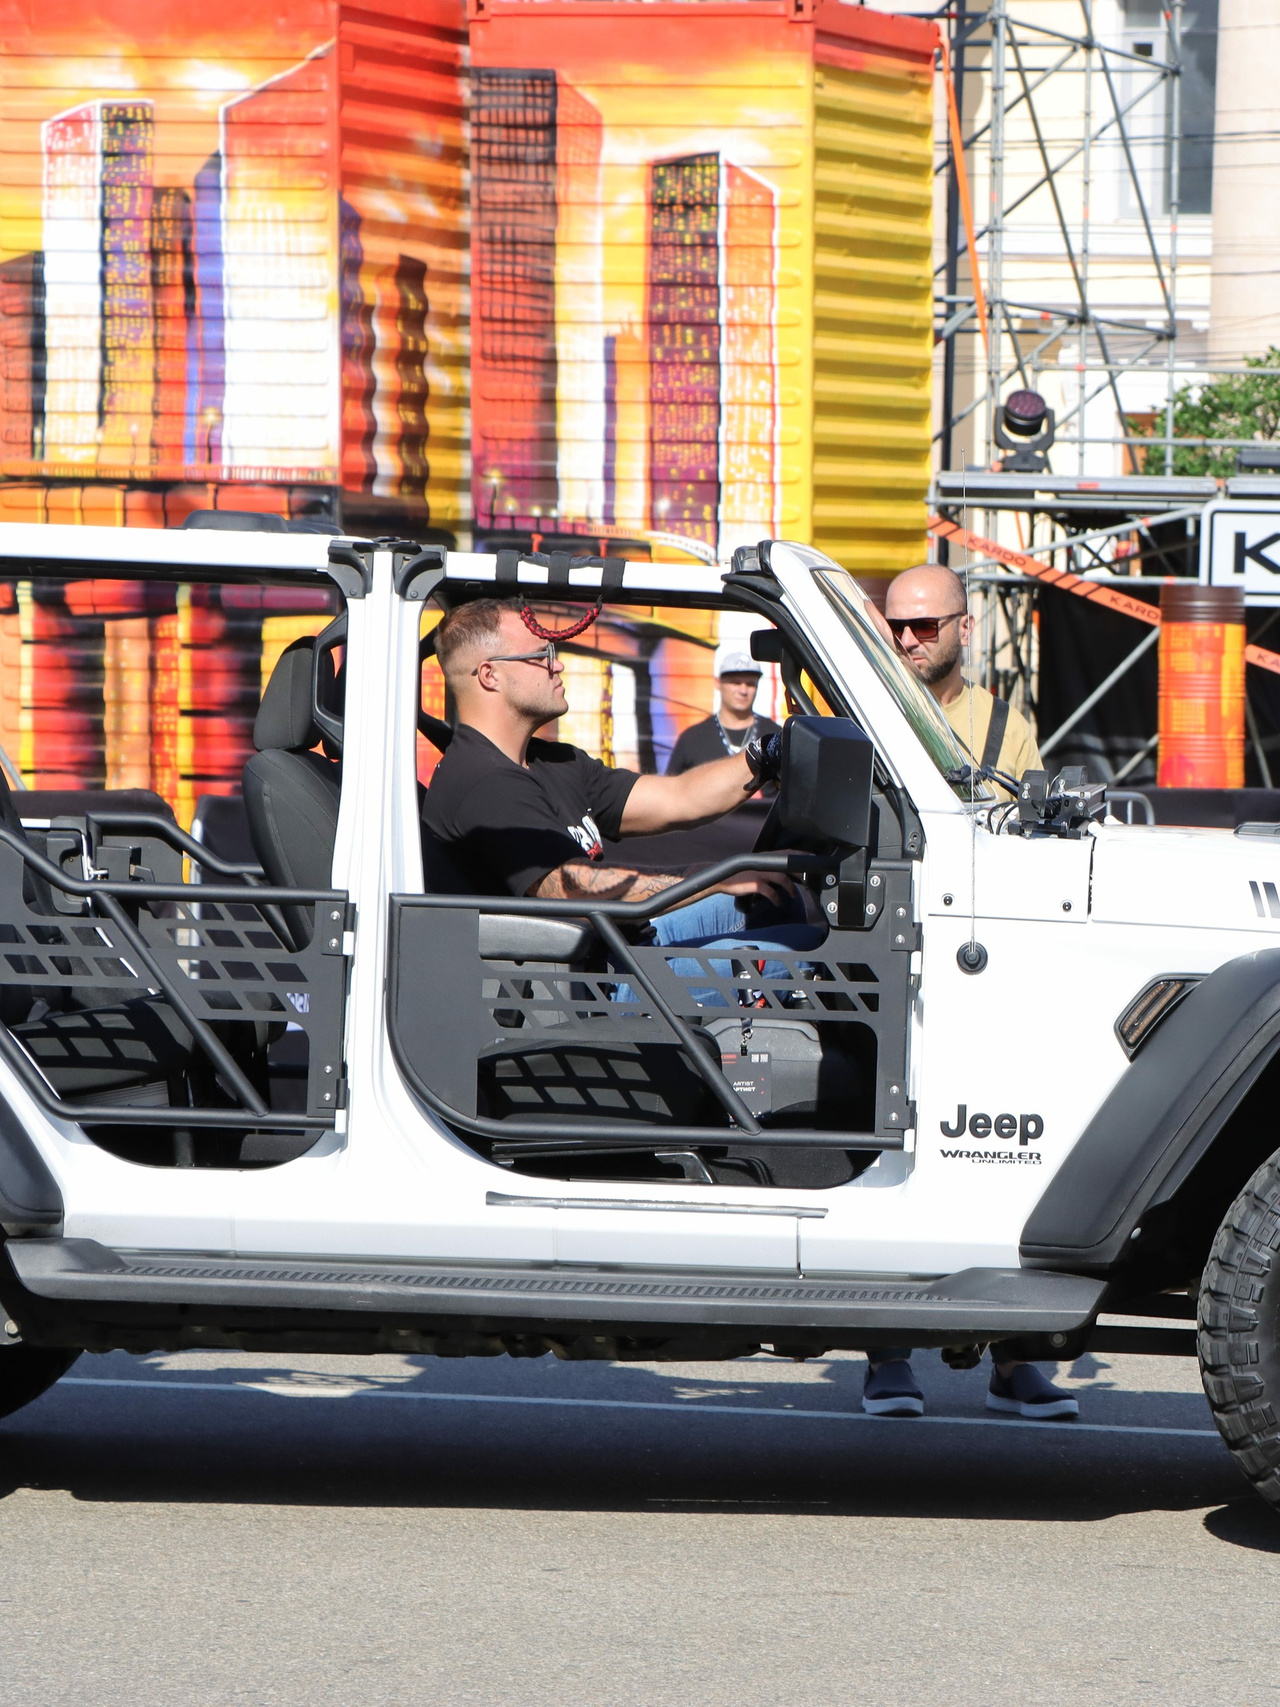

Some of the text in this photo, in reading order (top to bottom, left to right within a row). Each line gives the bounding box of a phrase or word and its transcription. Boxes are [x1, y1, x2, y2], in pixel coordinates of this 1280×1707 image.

[968, 536, 1027, 567] KARDO
[1110, 595, 1160, 621] KARD
[940, 1104, 1044, 1146] Jeep
[940, 1149, 1041, 1161] WRANGLER
